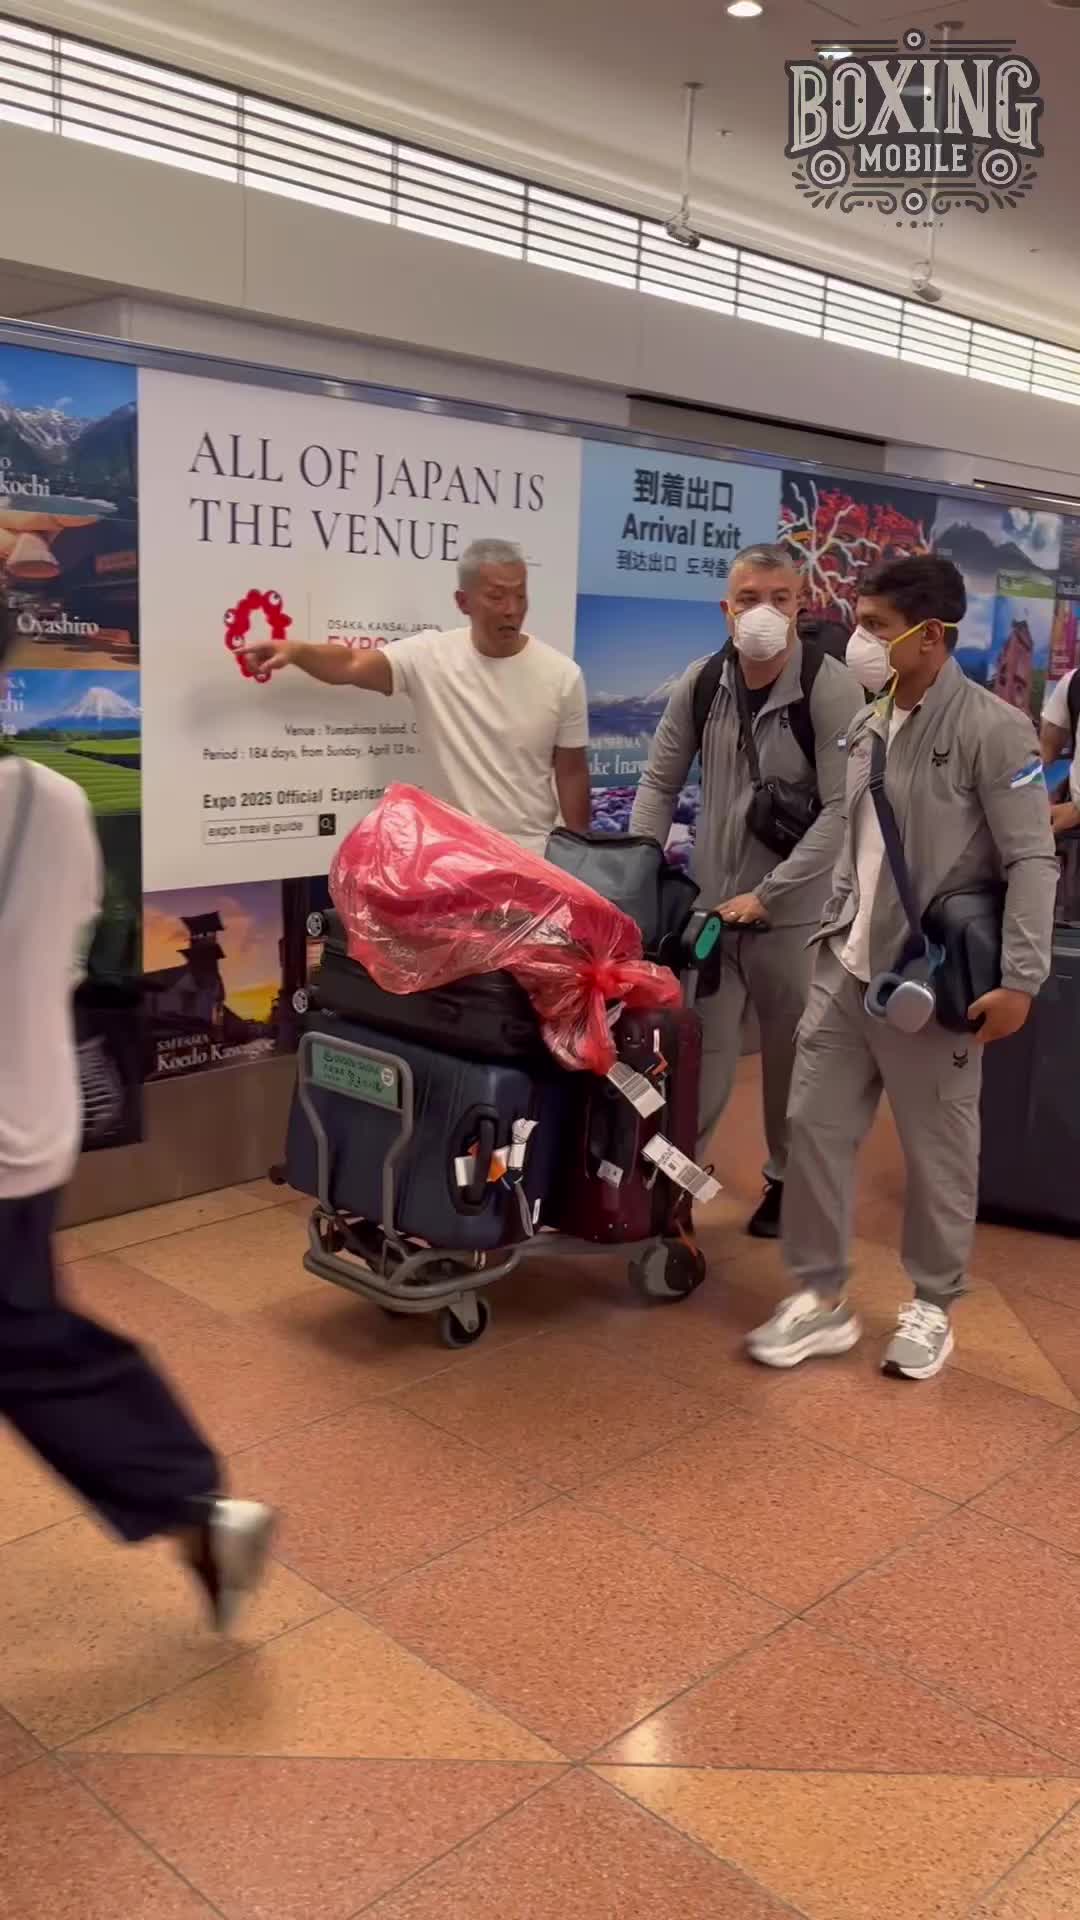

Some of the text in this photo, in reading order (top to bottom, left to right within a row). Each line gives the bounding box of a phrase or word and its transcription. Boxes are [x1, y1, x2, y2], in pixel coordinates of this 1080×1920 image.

[188, 430, 545, 512] ALL OF JAPAN IS
[632, 468, 733, 514] 到着出口
[190, 497, 460, 562] THE VENUE
[621, 512, 742, 550] Arrival Exit
[615, 549, 678, 573] 到达出口
[685, 557, 731, 579] 도착출
[17, 612, 100, 642] Oyashiro
[285, 723, 316, 737] Venue
[202, 747, 238, 761] Period
[248, 746, 269, 759] 184
[300, 744, 323, 758] from
[367, 743, 390, 757] April
[202, 786, 386, 811] Expo 2025 Official Experien
[207, 819, 304, 838] expo travel guide
